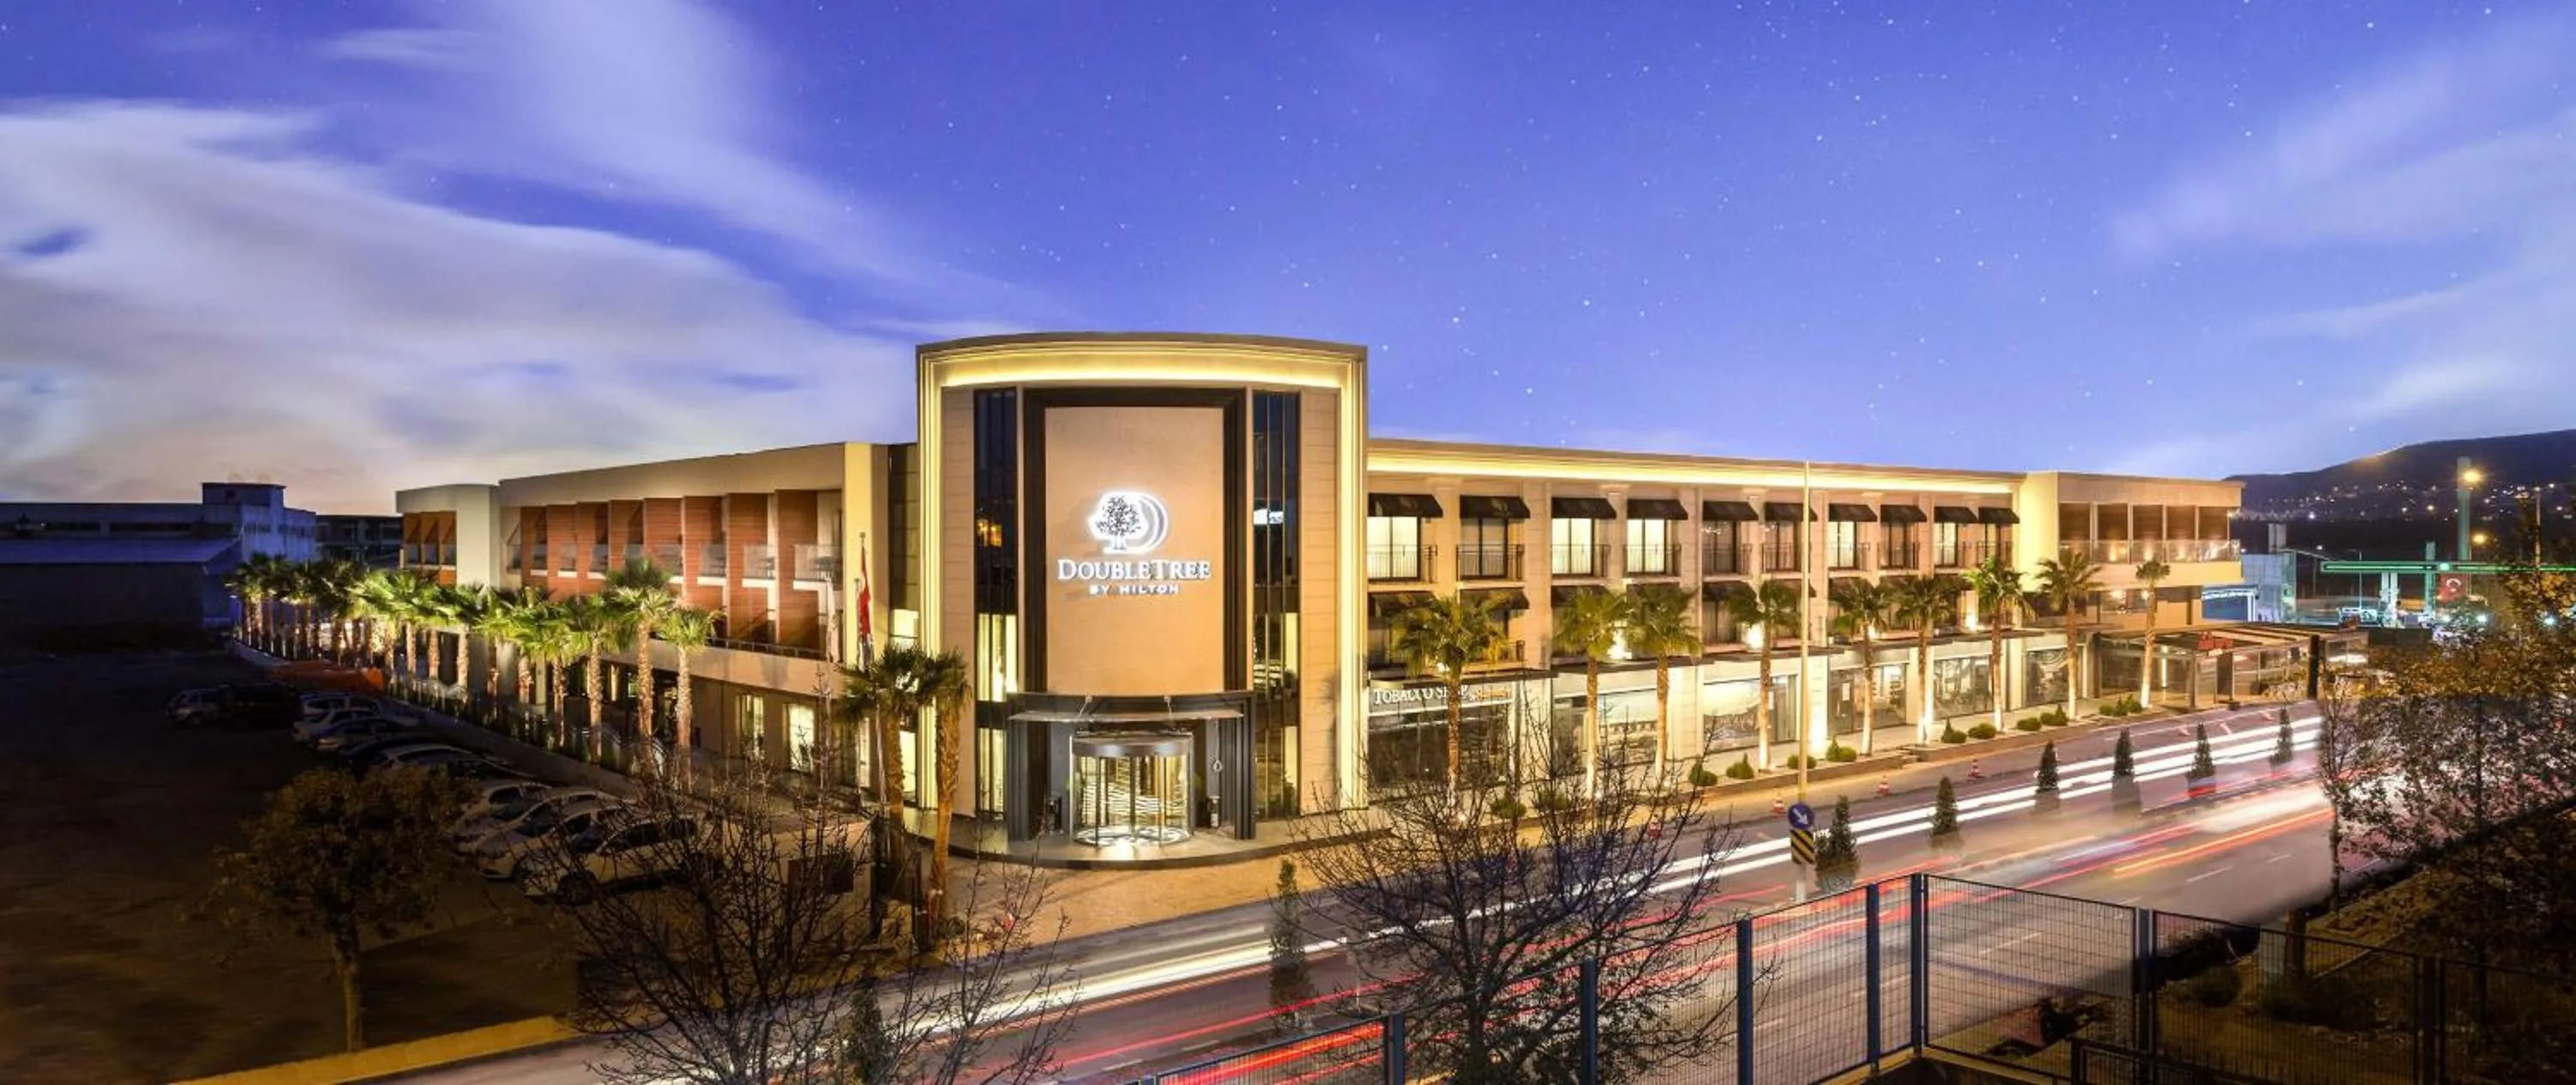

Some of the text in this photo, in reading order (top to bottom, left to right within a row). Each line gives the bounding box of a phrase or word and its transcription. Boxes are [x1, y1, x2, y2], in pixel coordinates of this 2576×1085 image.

[1090, 584, 1179, 594] BY HILTON
[1374, 688, 1433, 704] TOBACCO
[1436, 684, 1469, 700] SP
